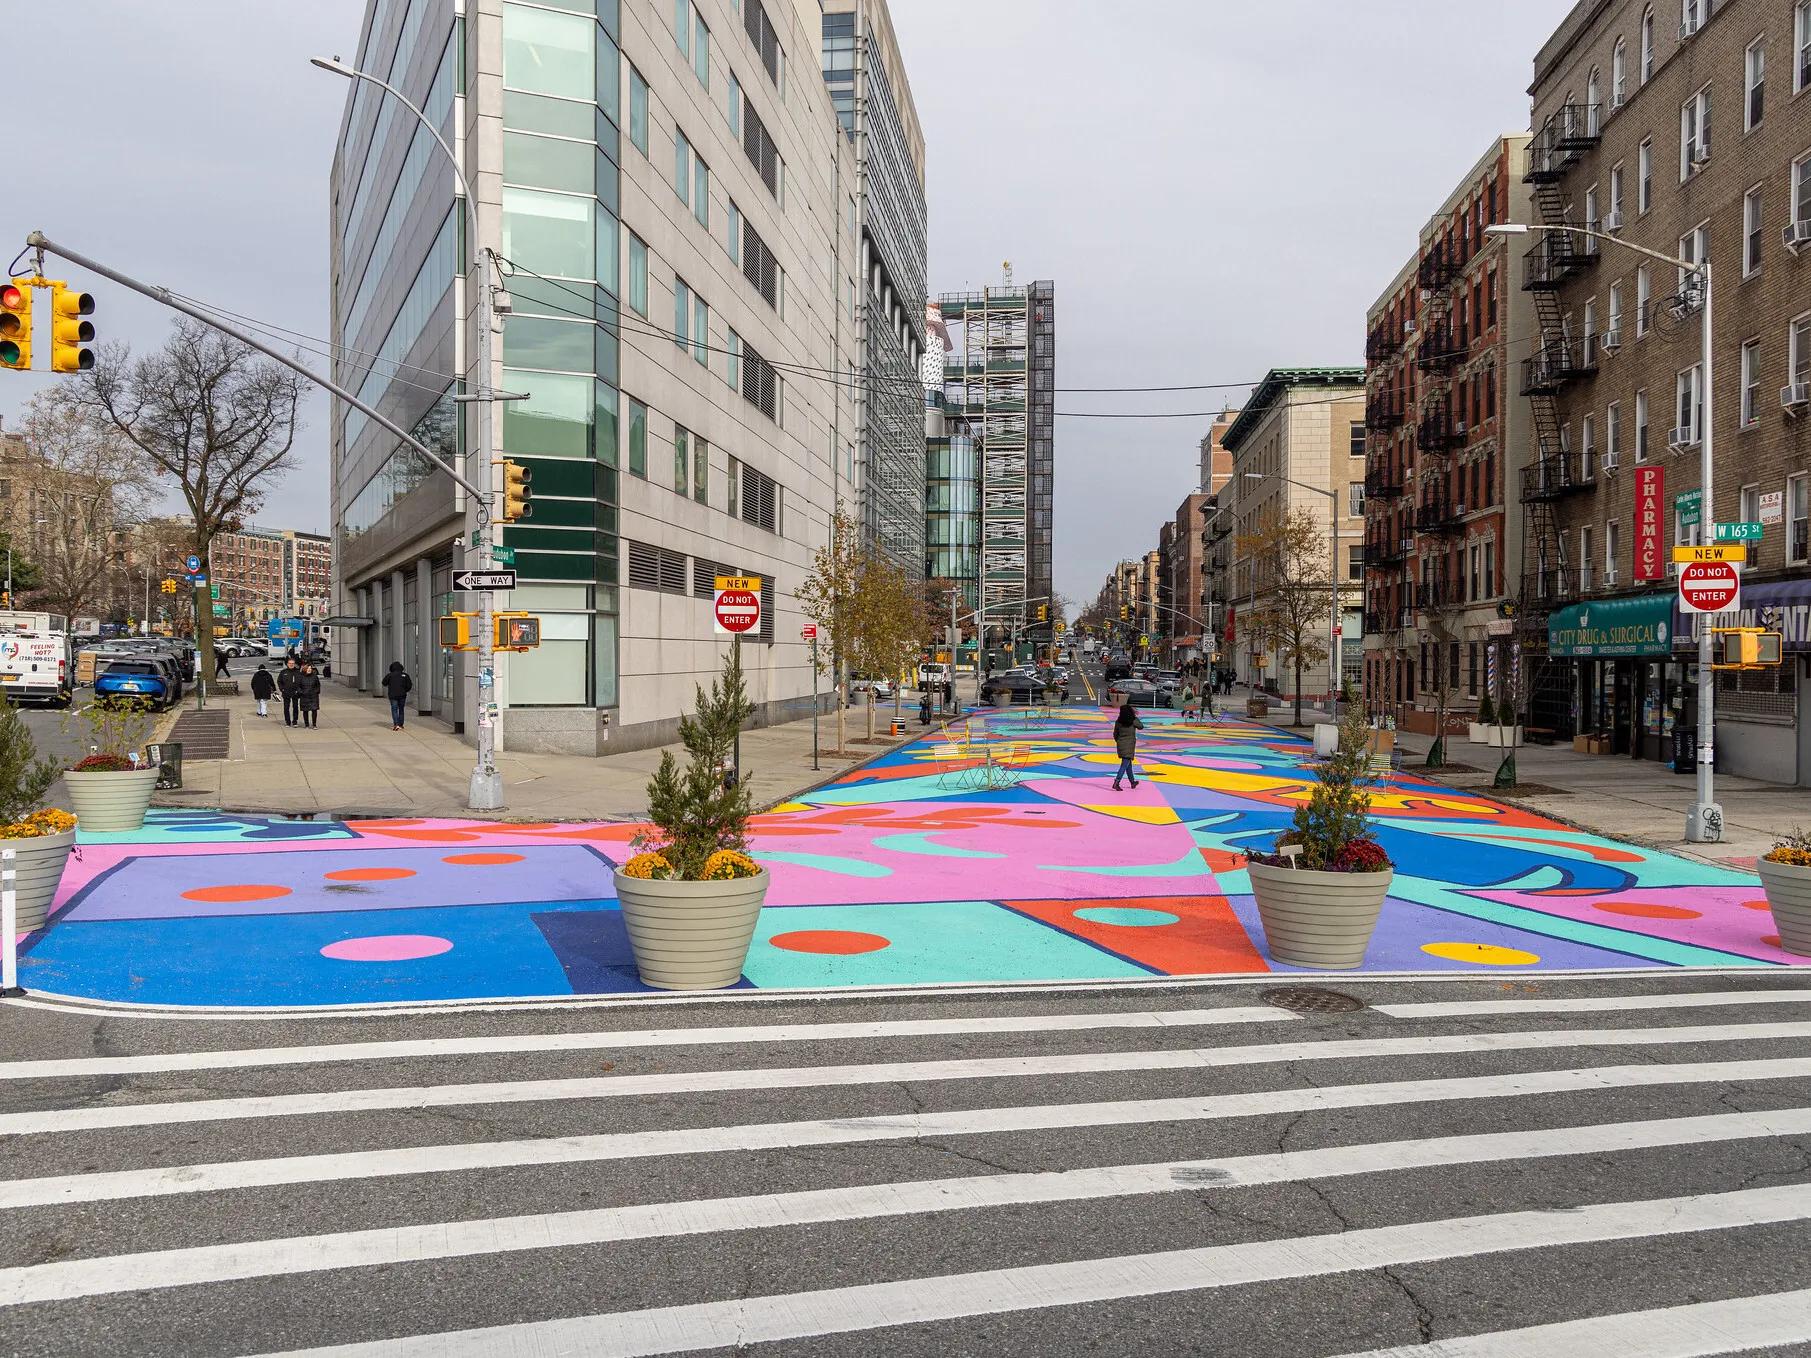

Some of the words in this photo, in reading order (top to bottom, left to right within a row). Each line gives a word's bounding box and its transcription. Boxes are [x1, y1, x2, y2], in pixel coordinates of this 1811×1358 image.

[1642, 470, 1656, 577] PHARMACY
[1718, 525, 1726, 537] W
[1731, 525, 1747, 537] 165
[1752, 524, 1759, 533] St
[1695, 549, 1723, 559] NEW
[1690, 568, 1704, 577] DO
[1707, 568, 1728, 577] NOT
[465, 577, 481, 585] ONE
[490, 576, 508, 584] WAY
[727, 580, 748, 588] NEW
[1692, 592, 1726, 600] ENTER
[724, 616, 750, 624] ENTER
[1558, 630, 1576, 645] CITY
[1577, 628, 1599, 645] DRUG
[1601, 631, 1607, 644] &
[1609, 625, 1655, 644] SURGICAL
[1644, 644, 1667, 652] PHARMACY
